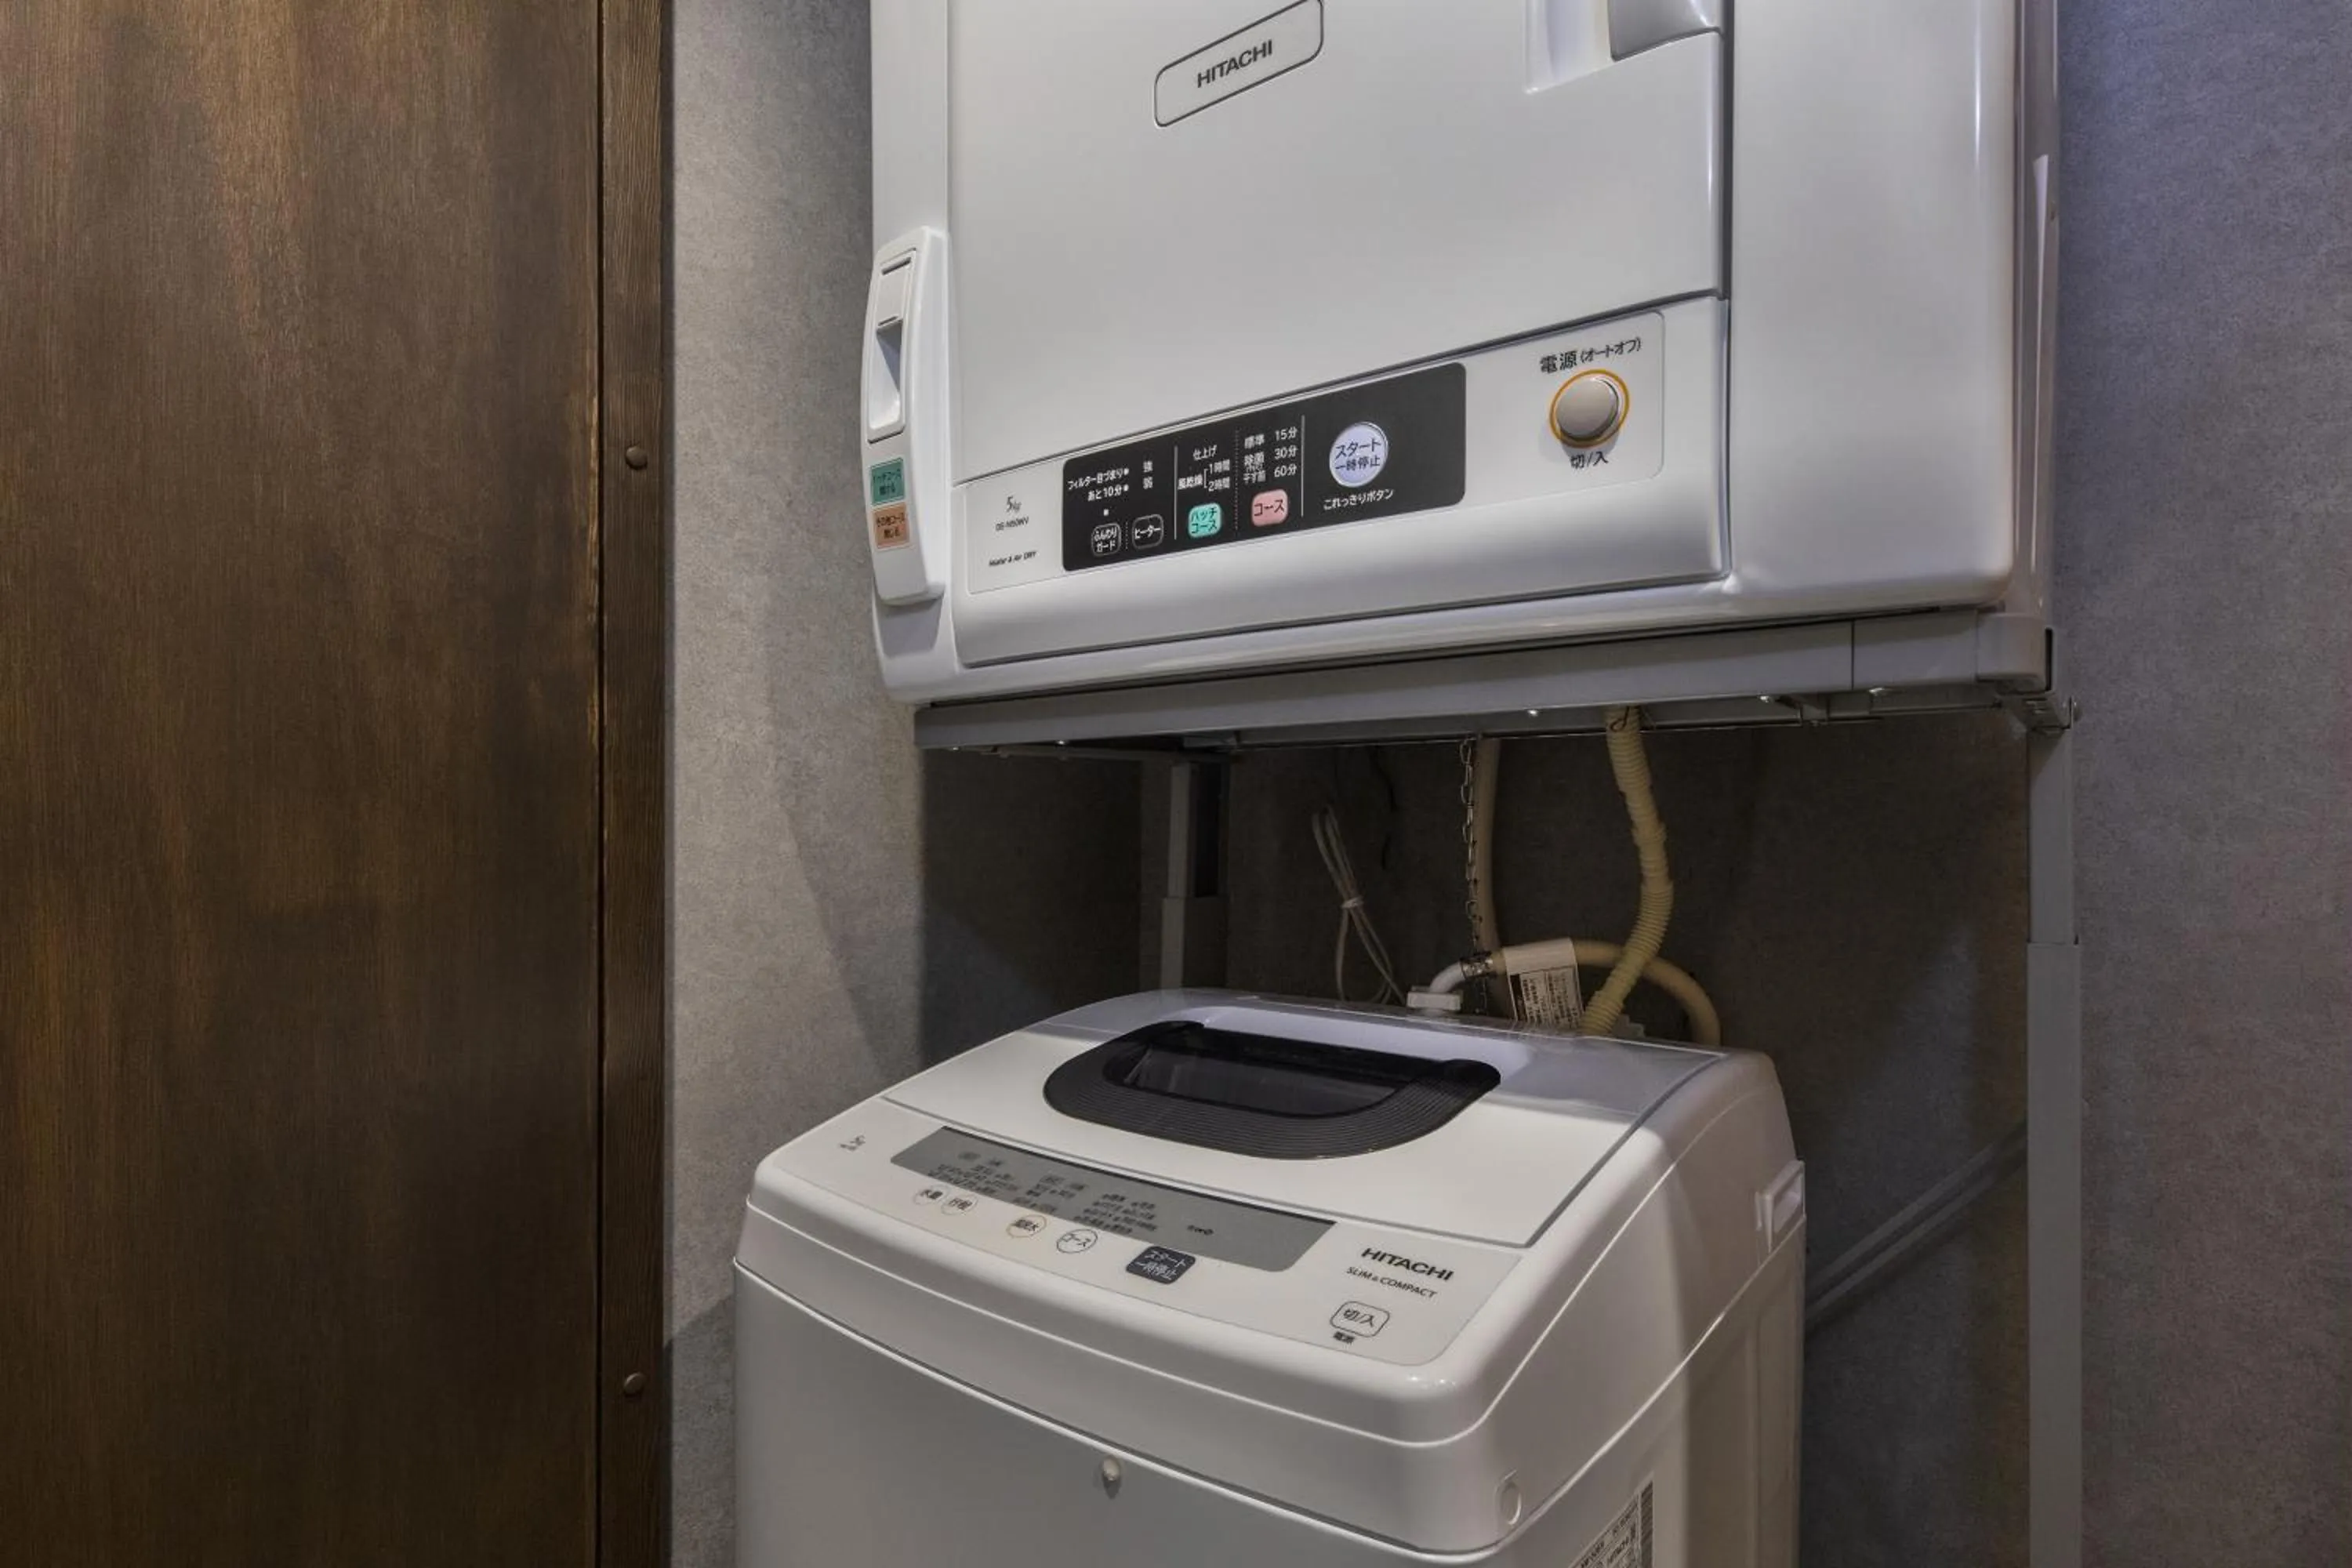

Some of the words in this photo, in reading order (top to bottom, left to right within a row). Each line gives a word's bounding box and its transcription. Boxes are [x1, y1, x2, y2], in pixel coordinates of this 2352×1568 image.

[1196, 40, 1272, 89] HITACHI
[1275, 426, 1298, 441] 15分
[1193, 445, 1218, 461] 仕上げ
[1274, 445, 1298, 460] 30分
[1335, 438, 1381, 459] スタート
[1210, 459, 1230, 474] 1時間
[1274, 463, 1297, 477] 60分
[1335, 455, 1381, 471] 一時停止
[1208, 477, 1230, 492] 2時間
[1087, 485, 1122, 502] あと10分
[1323, 488, 1394, 511] これっきりボタン
[1254, 499, 1285, 517] コース
[1134, 524, 1161, 539] ヒーター
[1361, 1247, 1454, 1281] HITACHI
[1346, 1266, 1372, 1279] SLIM
[1380, 1276, 1438, 1298] COMPACT
